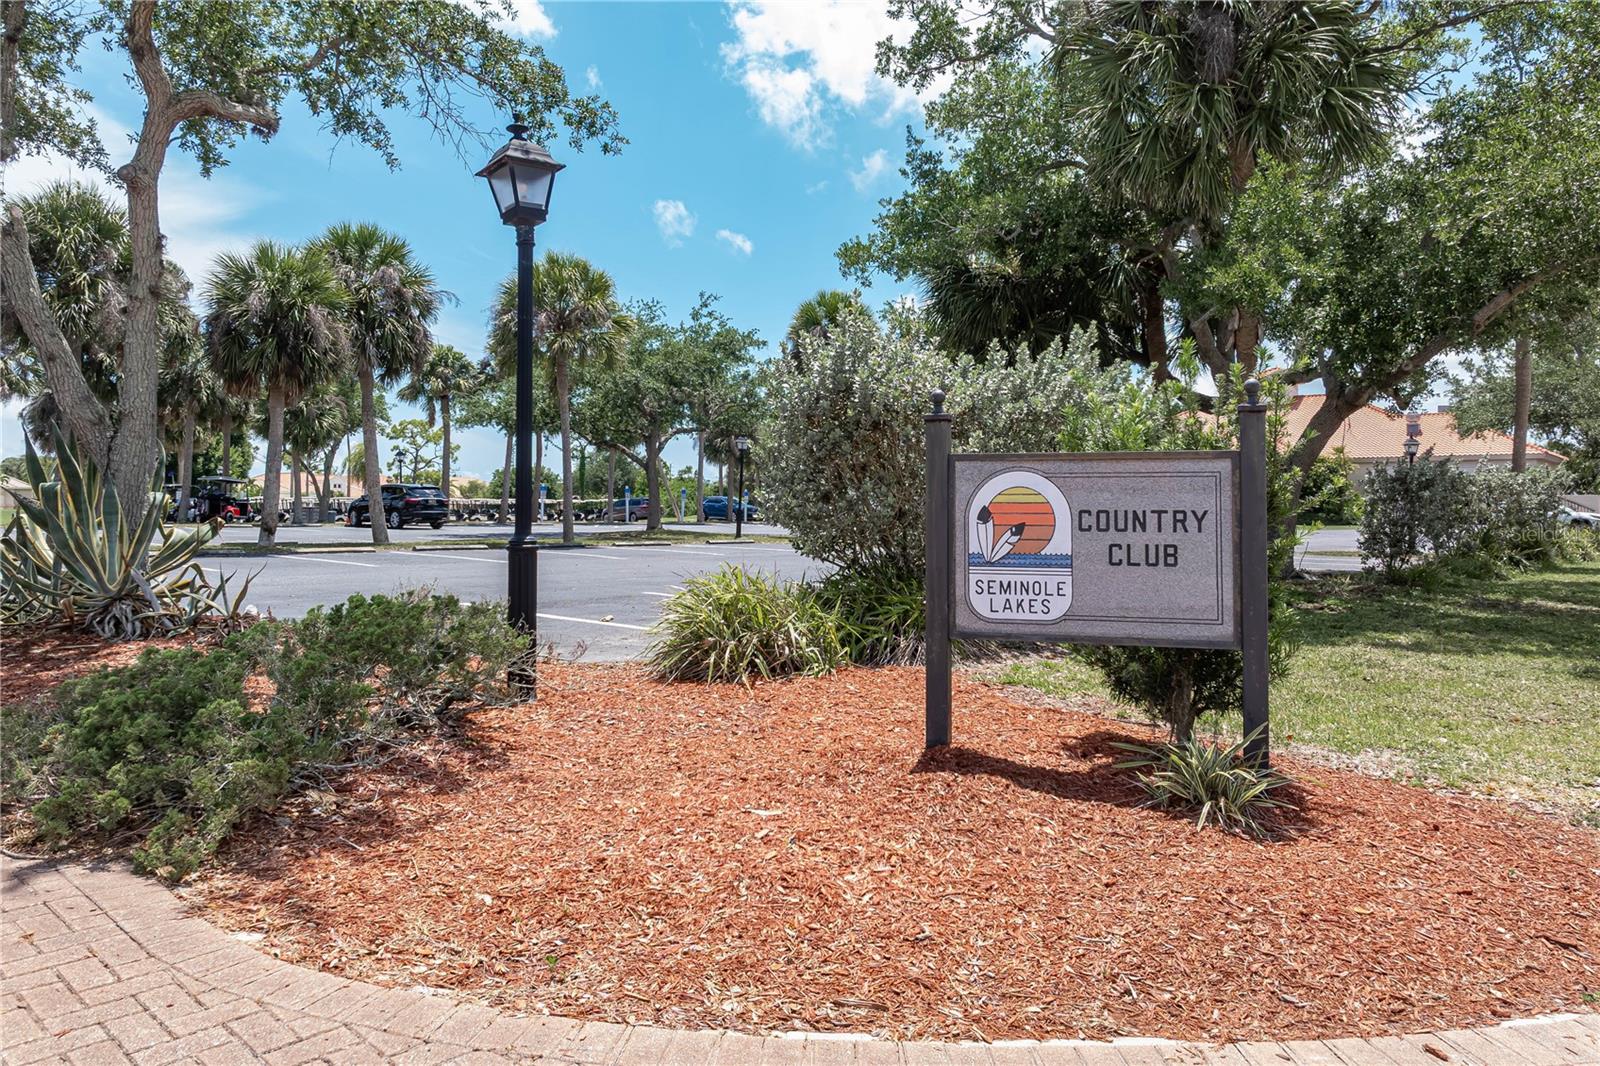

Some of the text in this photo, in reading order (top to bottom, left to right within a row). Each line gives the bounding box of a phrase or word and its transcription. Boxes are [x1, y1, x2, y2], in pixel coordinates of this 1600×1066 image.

[1078, 509, 1209, 533] COUNTRY
[1108, 543, 1178, 567] CLUB
[975, 579, 1066, 597] SEMINOLE
[989, 597, 1051, 615] LAKES
